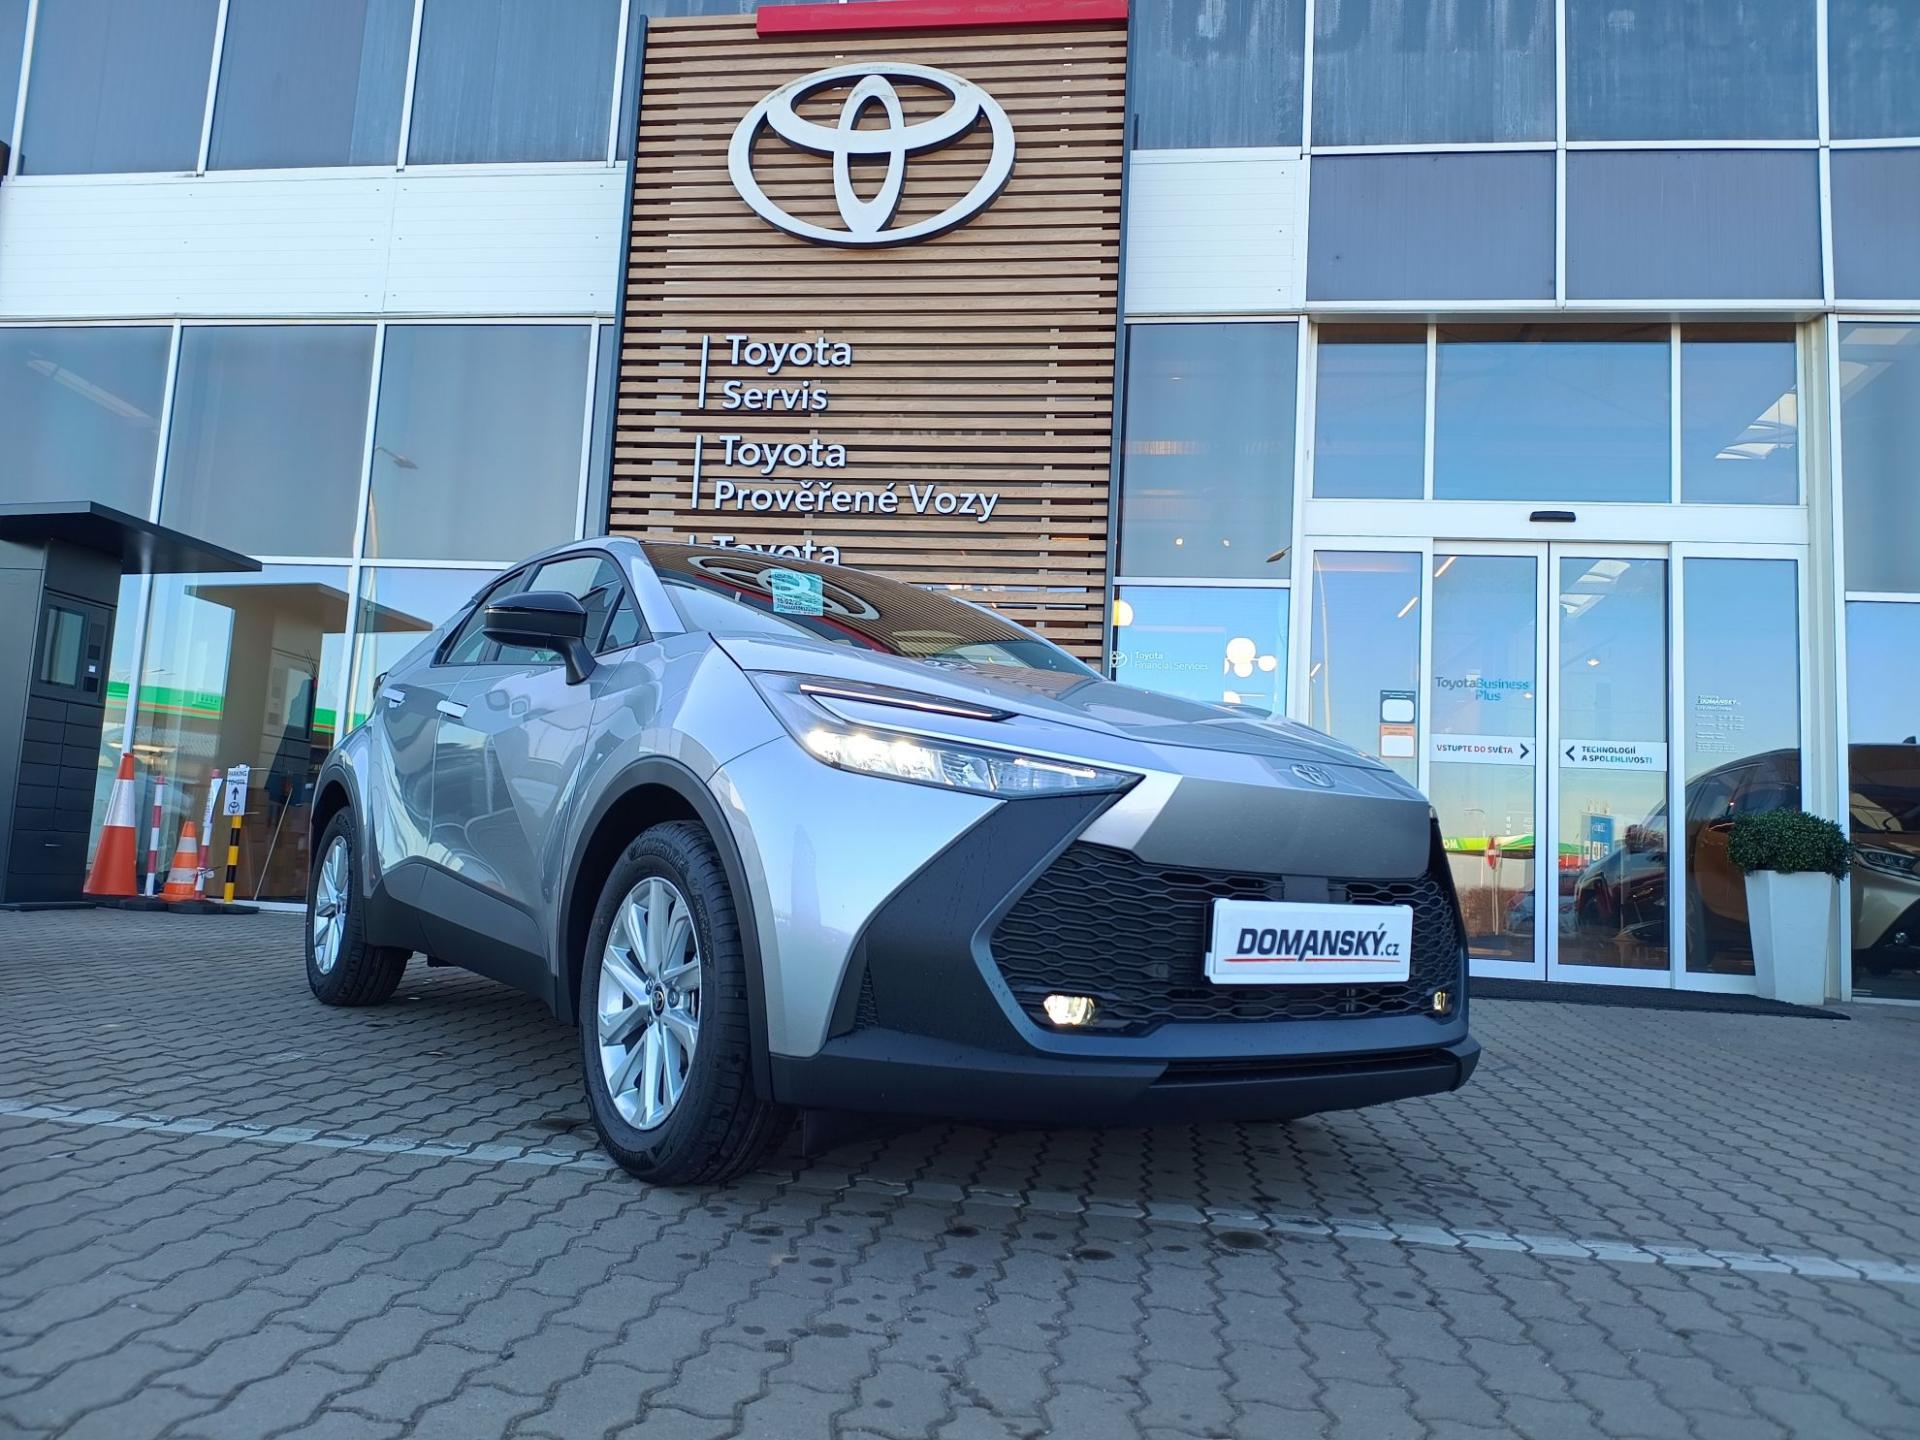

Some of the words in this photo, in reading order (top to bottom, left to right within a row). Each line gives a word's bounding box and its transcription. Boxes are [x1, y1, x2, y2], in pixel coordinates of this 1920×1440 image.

[725, 335, 852, 374] Toyota
[721, 380, 828, 410] Servis
[719, 435, 846, 474] Toyota
[714, 480, 898, 513] Prověřené
[908, 484, 999, 523] Vozy
[1475, 689, 1501, 701] Plus
[1436, 744, 1472, 752] VSTUPTE
[1474, 745, 1486, 753] DO
[1589, 755, 1653, 764] SPOLEHLIVOSTI
